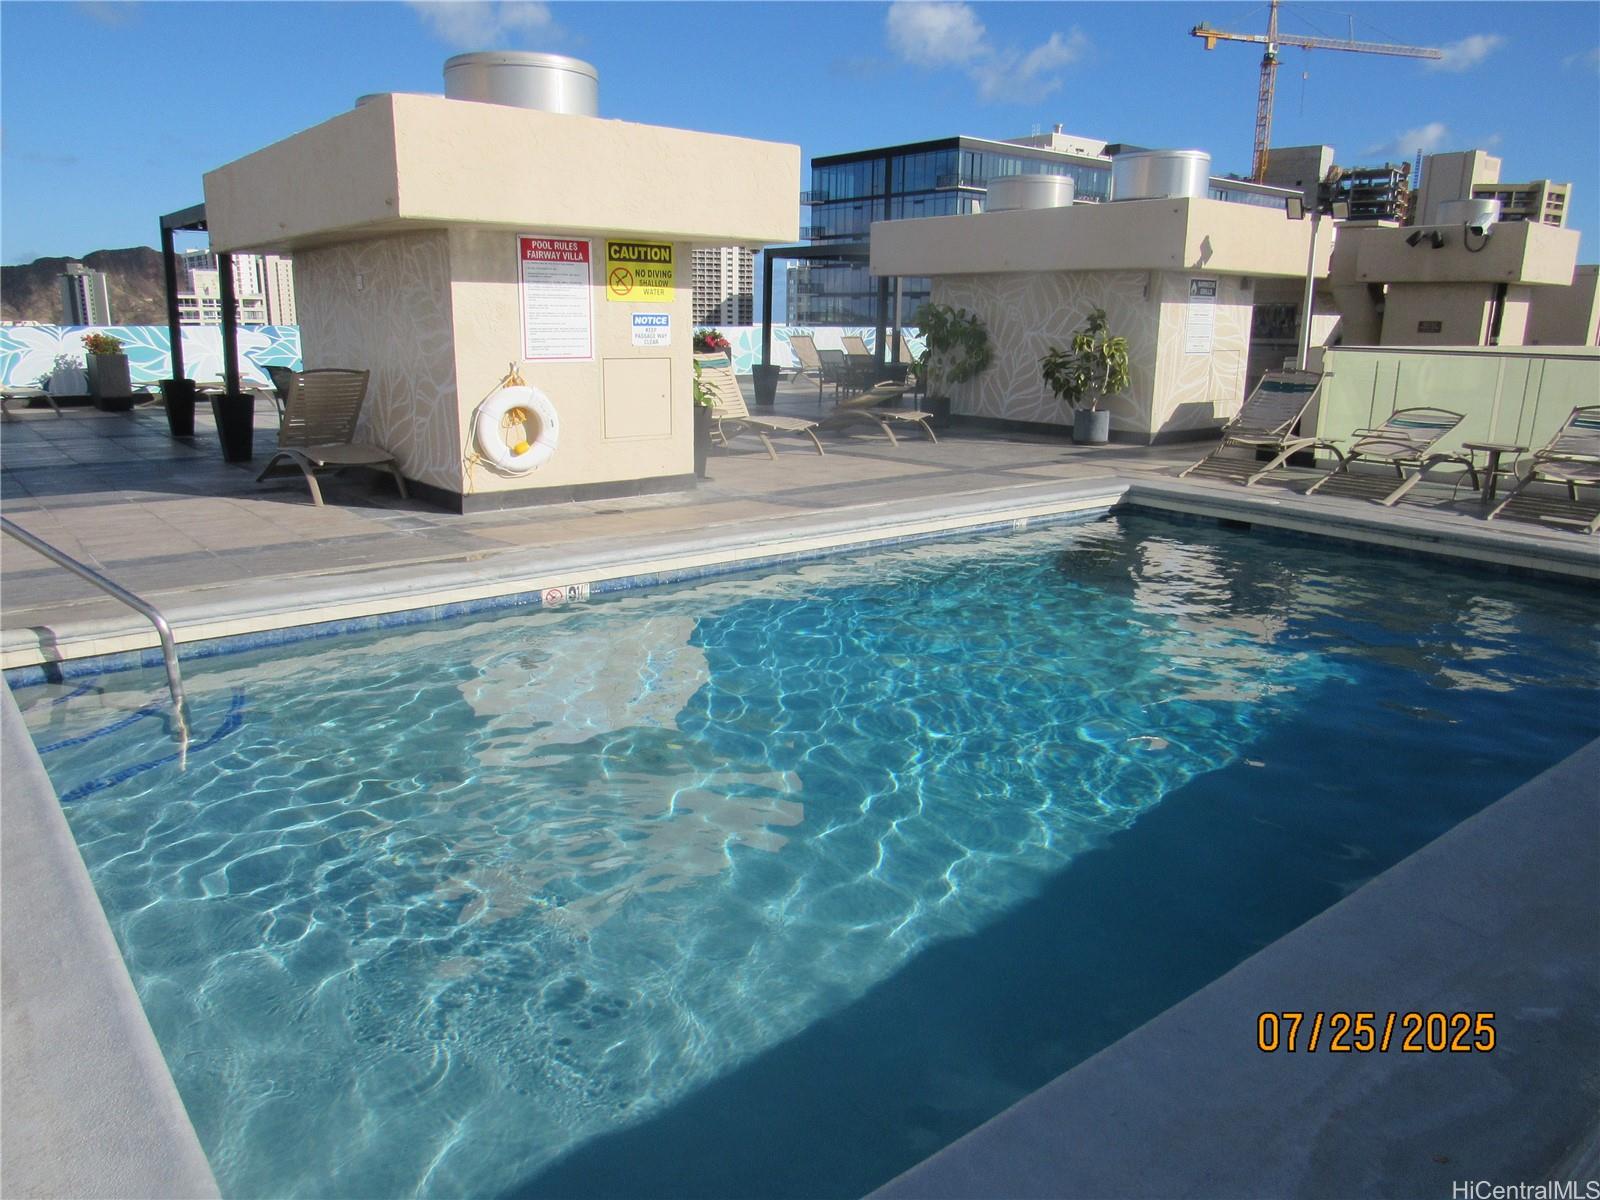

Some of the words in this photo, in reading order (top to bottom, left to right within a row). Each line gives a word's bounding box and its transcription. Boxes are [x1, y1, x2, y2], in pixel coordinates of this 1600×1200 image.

[531, 240, 552, 250] POOL
[554, 241, 578, 251] RULES
[527, 249, 561, 260] FAIRWAY
[563, 251, 584, 260] VILLA
[610, 244, 670, 261] CAUTION
[635, 269, 646, 278] NO
[647, 269, 672, 279] DIVING
[639, 279, 669, 287] SHALLOW
[643, 288, 665, 296] WATER
[634, 316, 668, 325] NOTICE
